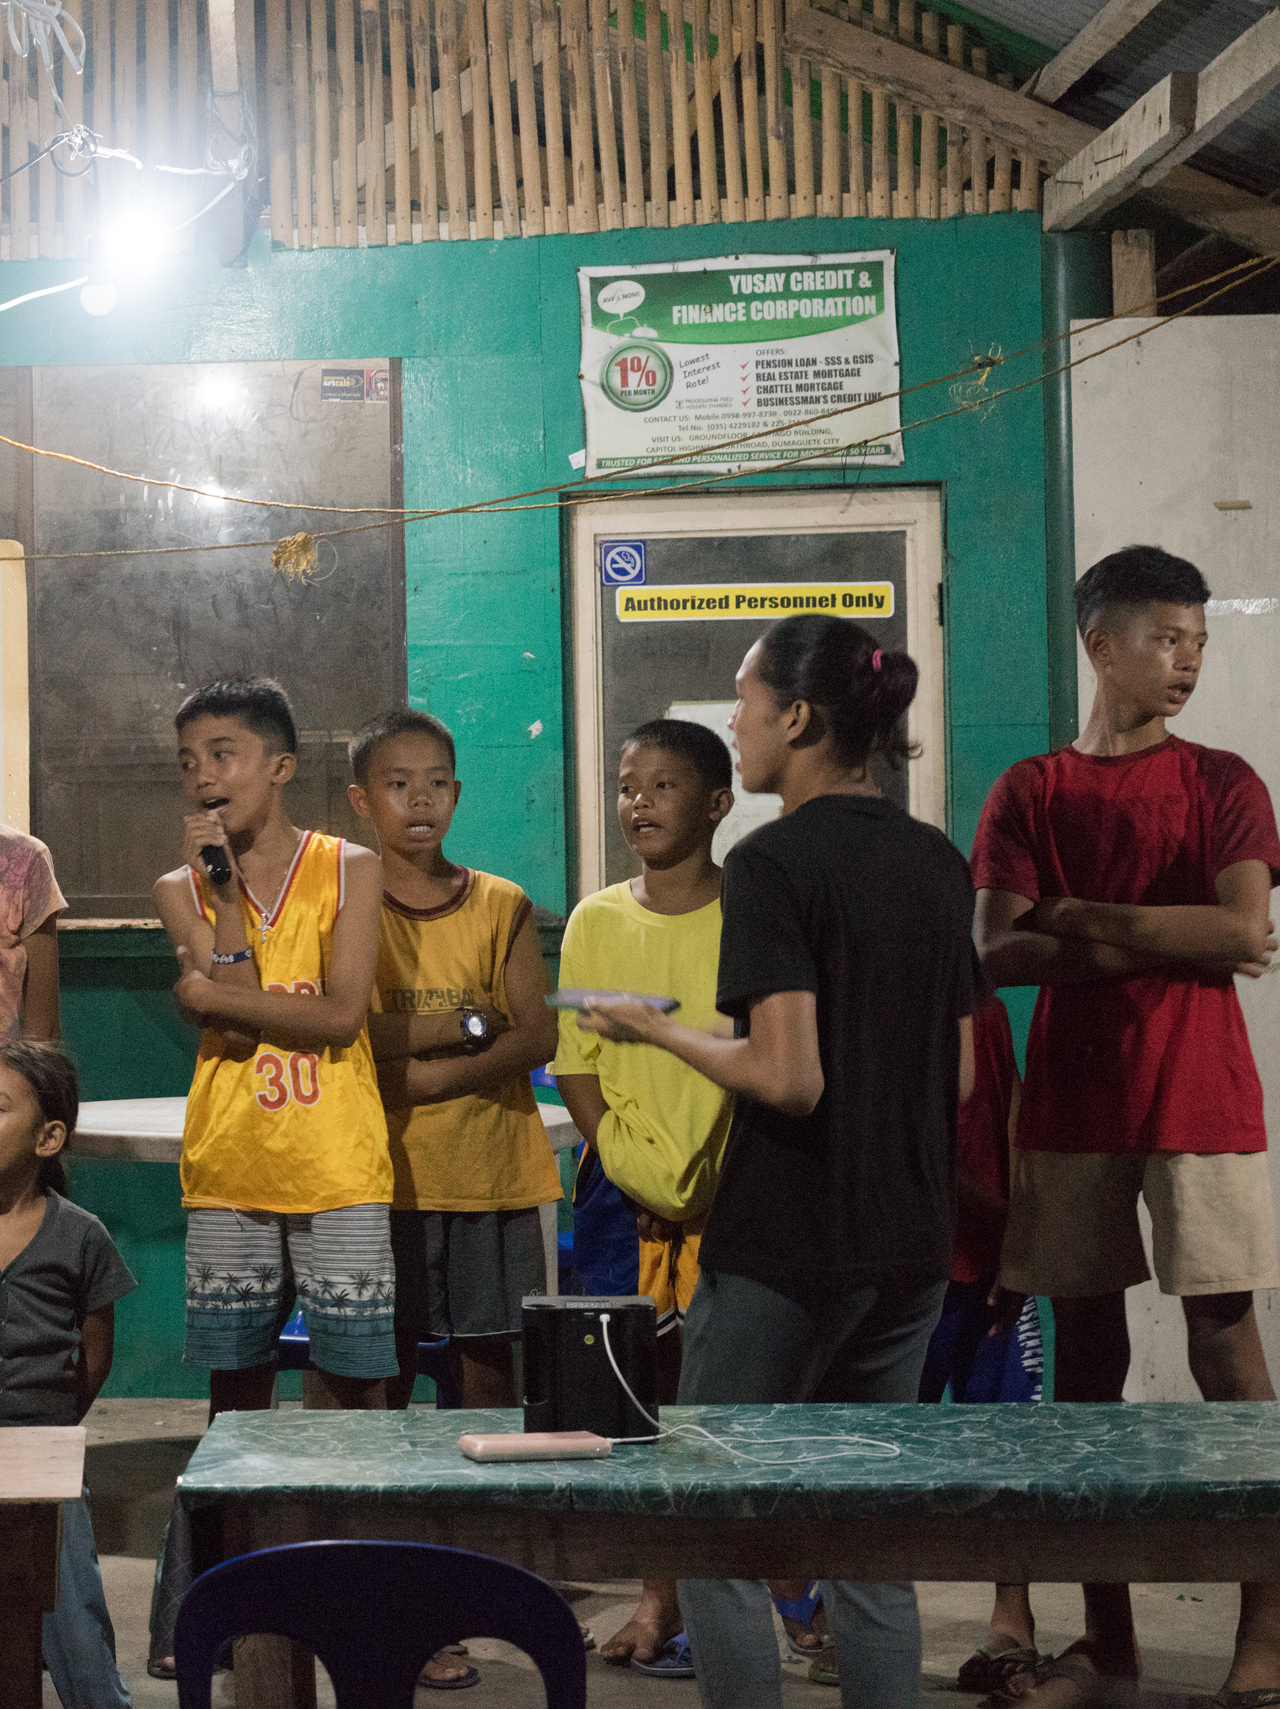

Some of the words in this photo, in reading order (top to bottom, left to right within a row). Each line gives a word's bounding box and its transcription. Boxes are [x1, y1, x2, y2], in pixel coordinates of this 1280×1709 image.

[729, 272, 786, 295] YUSAY
[790, 269, 854, 292] CREDIT
[858, 271, 871, 288] &
[672, 302, 746, 325] FINANCE
[750, 295, 876, 321] CORPORATION
[755, 348, 787, 356] OFFERS:
[679, 353, 710, 368] Lowest
[755, 358, 793, 369] PENSION
[795, 357, 817, 368] LOAN
[824, 356, 842, 366] SSS
[844, 356, 850, 365] &
[852, 354, 874, 364] GSIS
[615, 355, 657, 388] 1%
[683, 361, 721, 379] Interest
[756, 371, 776, 382] REAL
[779, 370, 809, 381] ESTATE
[813, 368, 861, 379] MORTGAGE
[686, 376, 709, 389] Rate!
[756, 384, 793, 395] CHATTEL
[796, 381, 844, 393] MORTGAGE
[621, 389, 632, 397] PER
[633, 387, 656, 396] MONTH
[757, 395, 828, 407] BUSINESSMAN'S
[830, 392, 862, 404] CREDIT
[694, 413, 719, 421] Mobile
[707, 423, 726, 431] (035)
[719, 441, 769, 451] ORTHROAD,
[772, 439, 821, 448] DUMAGUETE
[601, 458, 636, 468] TRUSTED
[636, 457, 652, 466] FOR
[692, 453, 749, 463] PERSONALIZED
[750, 452, 781, 460] SERVICE
[861, 446, 885, 454] YEARS
[624, 595, 729, 612] Authorized
[735, 593, 837, 610] Personnel
[841, 593, 885, 609] Only
[255, 1051, 321, 1111] 30
